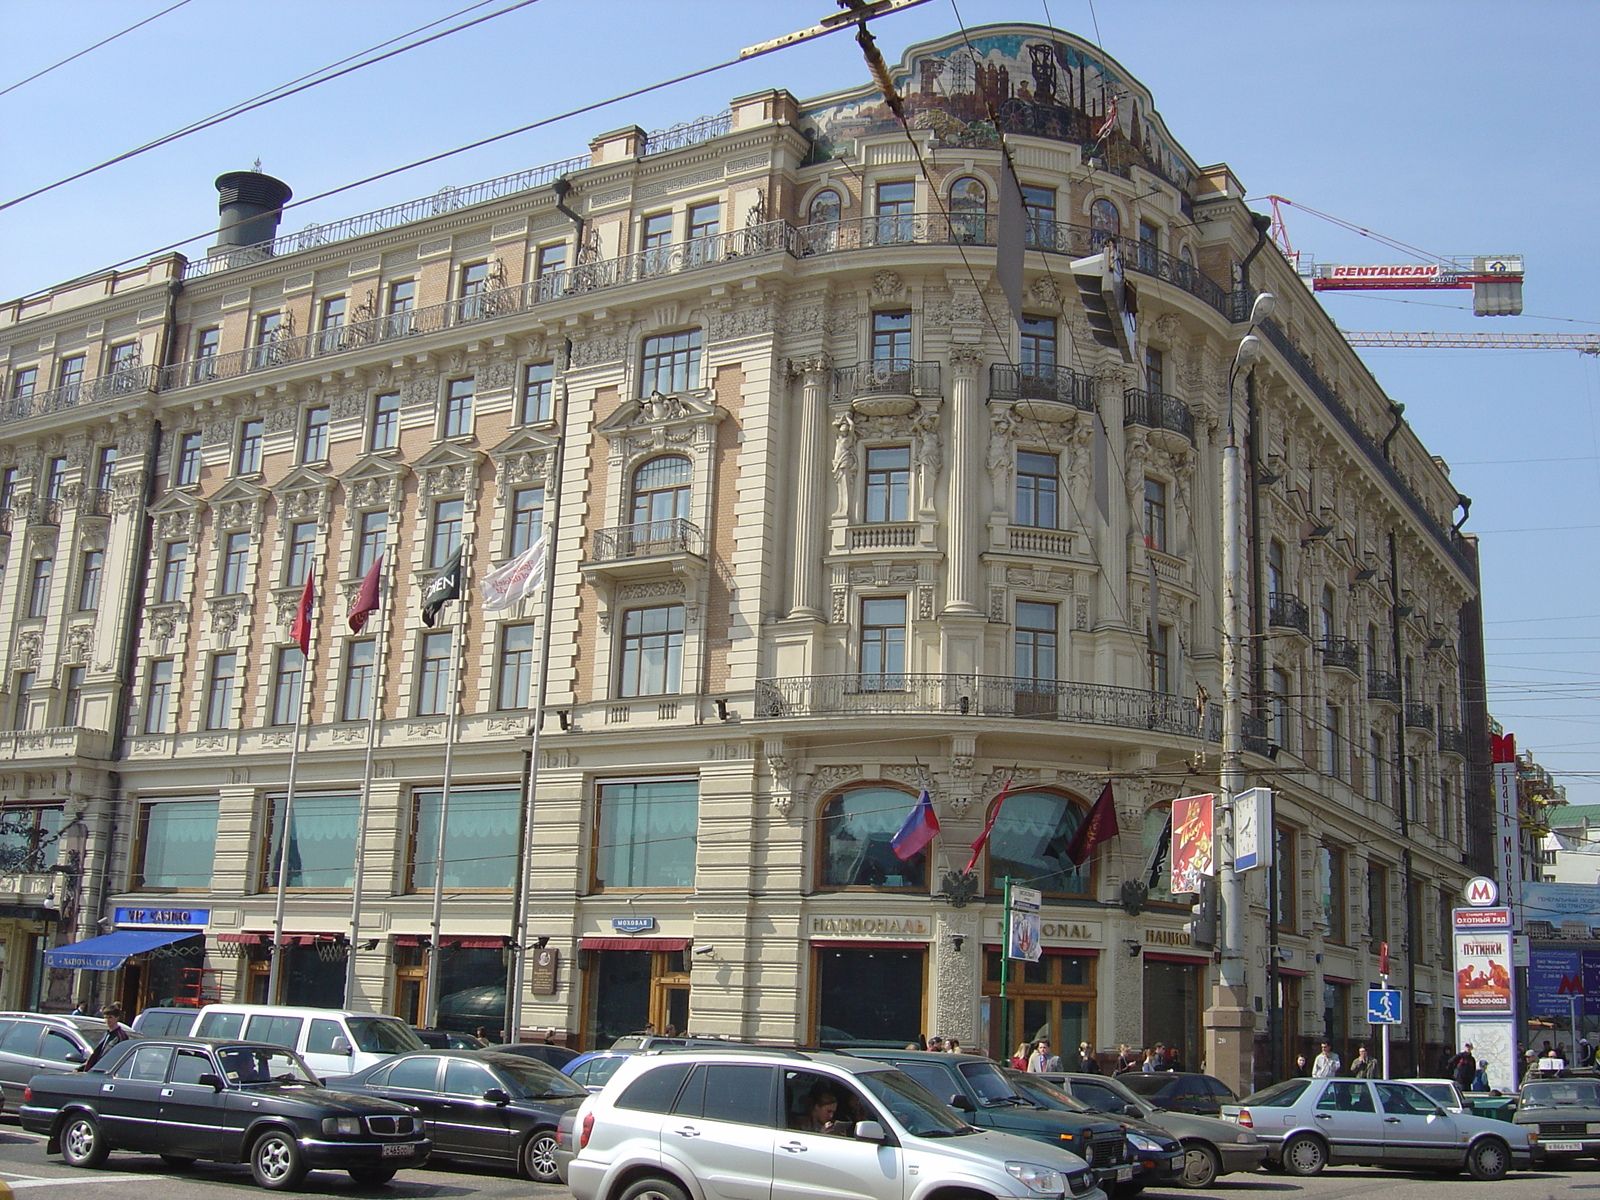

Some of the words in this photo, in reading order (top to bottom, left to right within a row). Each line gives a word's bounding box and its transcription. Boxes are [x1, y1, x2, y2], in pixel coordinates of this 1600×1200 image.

[1333, 265, 1438, 277] RENTAKRAN
[128, 910, 144, 921] VIP
[150, 910, 190, 921] CASINO
[1456, 916, 1491, 924] ОХОТНЫЙ
[813, 917, 927, 933] НАЦИОНАЛЬ
[1463, 943, 1502, 955] ПУТИНКИ
[63, 957, 93, 966] NATIONAL
[95, 959, 111, 967] CLUB
